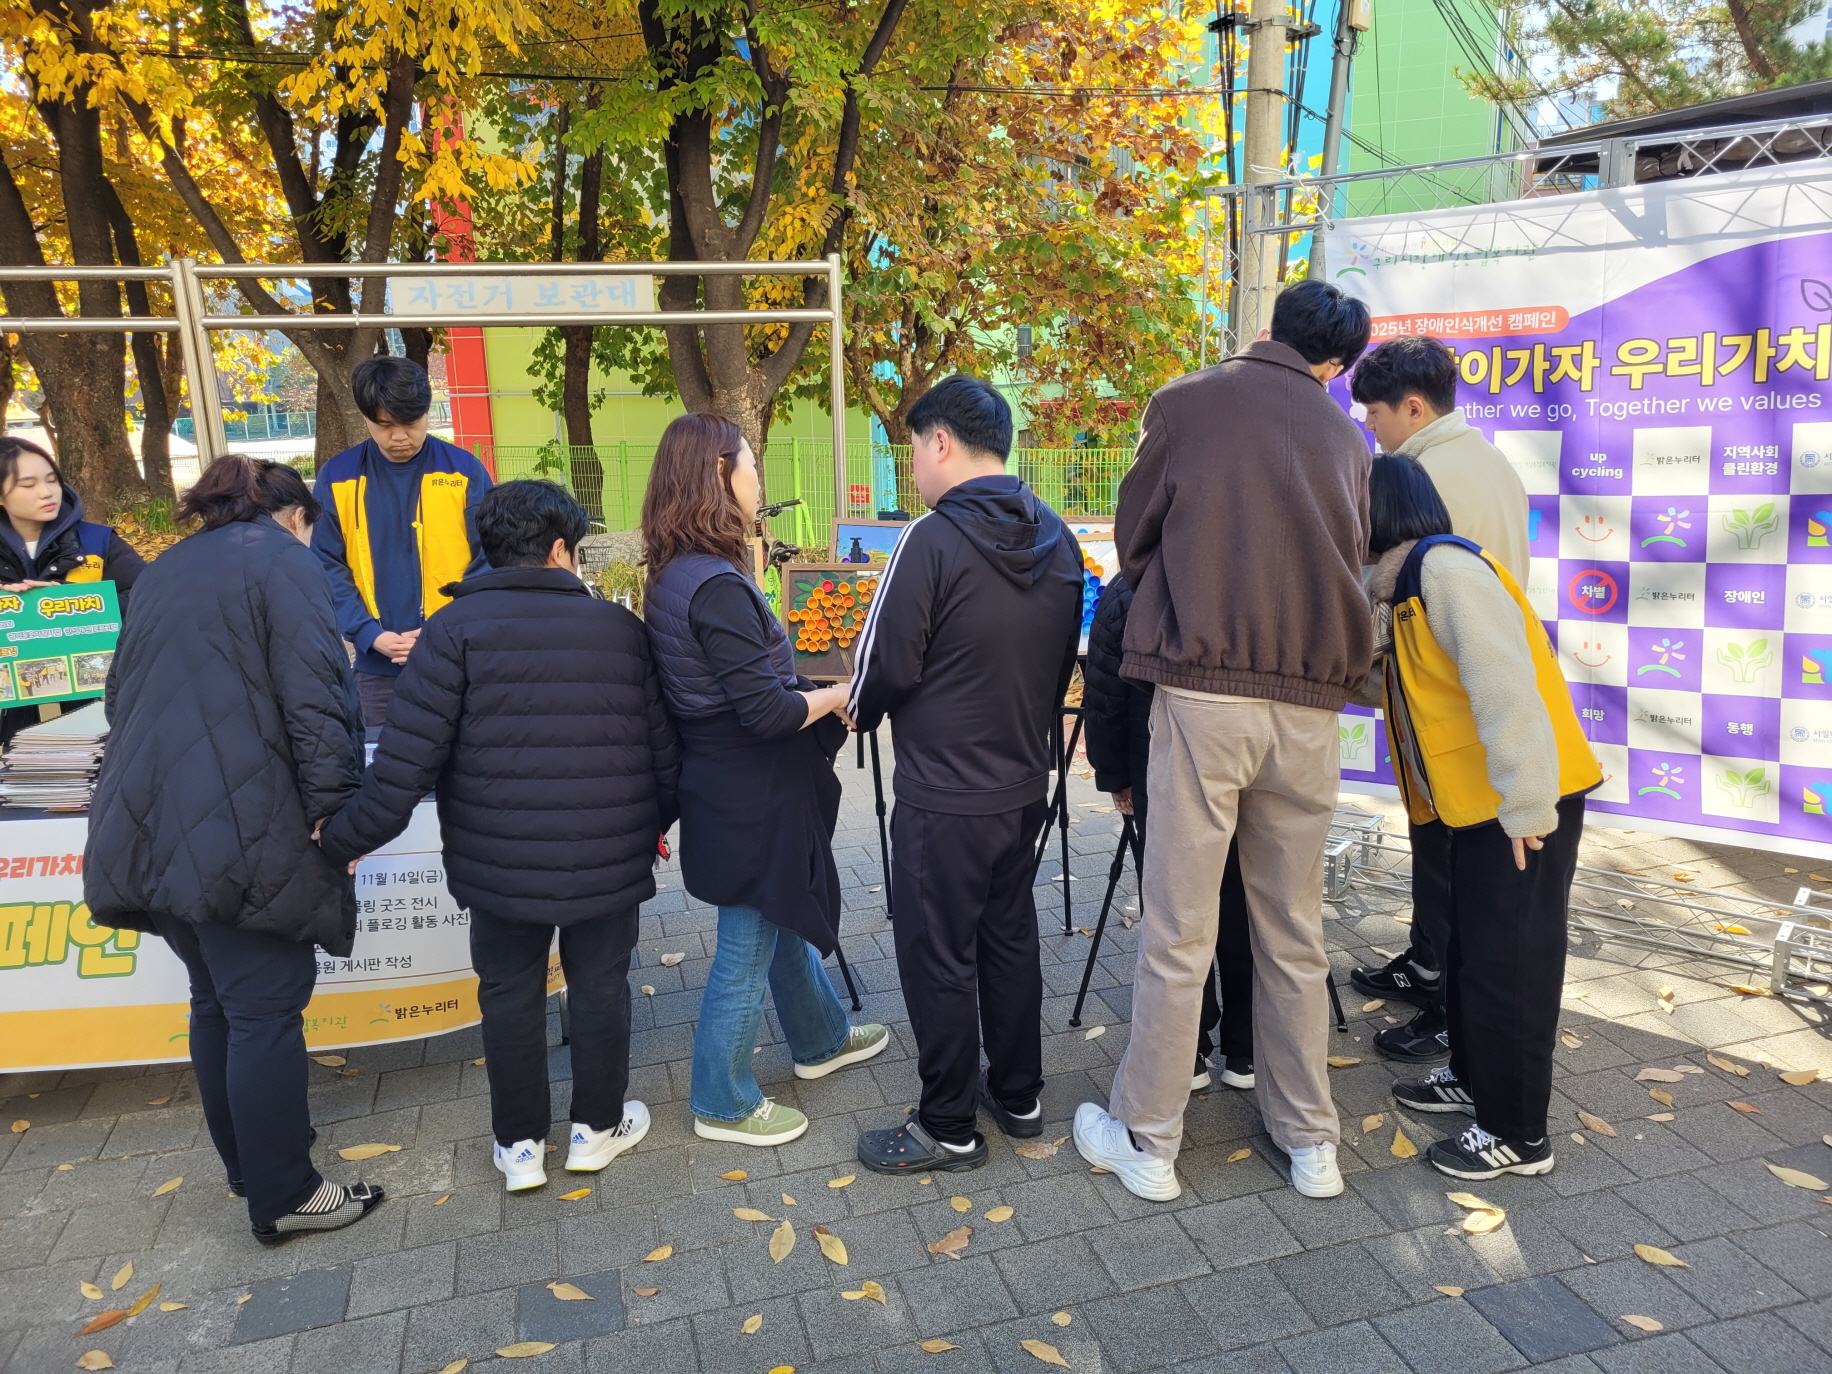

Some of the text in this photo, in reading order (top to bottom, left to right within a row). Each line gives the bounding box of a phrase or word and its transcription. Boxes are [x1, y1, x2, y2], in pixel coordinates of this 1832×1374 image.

[408, 278, 637, 311] 자전거 보관대
[1371, 310, 1557, 337] 025년 장애인식개선 캠페인
[1448, 322, 1832, 395] 이가자 우리가치
[1456, 390, 1823, 423] ther we go, Together we values
[1589, 452, 1608, 464] up
[1656, 455, 1701, 466] 밝은누리터
[1722, 445, 1779, 460] 지역사회
[1571, 466, 1624, 479] cycling
[1721, 461, 1779, 476] 클린환경
[1581, 585, 1606, 600] 차별
[1651, 591, 1696, 602] 밝은누리터
[1723, 589, 1766, 605] 장애인
[40, 596, 102, 617] 우리가치
[1581, 708, 1606, 722] 희망
[1650, 714, 1693, 727] 밝은누리터
[1726, 721, 1754, 736] 동행
[361, 870, 444, 886] 11월 14일(금)
[380, 898, 408, 913] 굿즈
[410, 896, 438, 911] 전시
[366, 917, 408, 933] 플로깅
[411, 915, 439, 930] 활동
[442, 912, 469, 927] 사진
[340, 957, 382, 974] 게시판
[385, 955, 413, 970] 작성
[395, 999, 459, 1020] 밝은누리터
